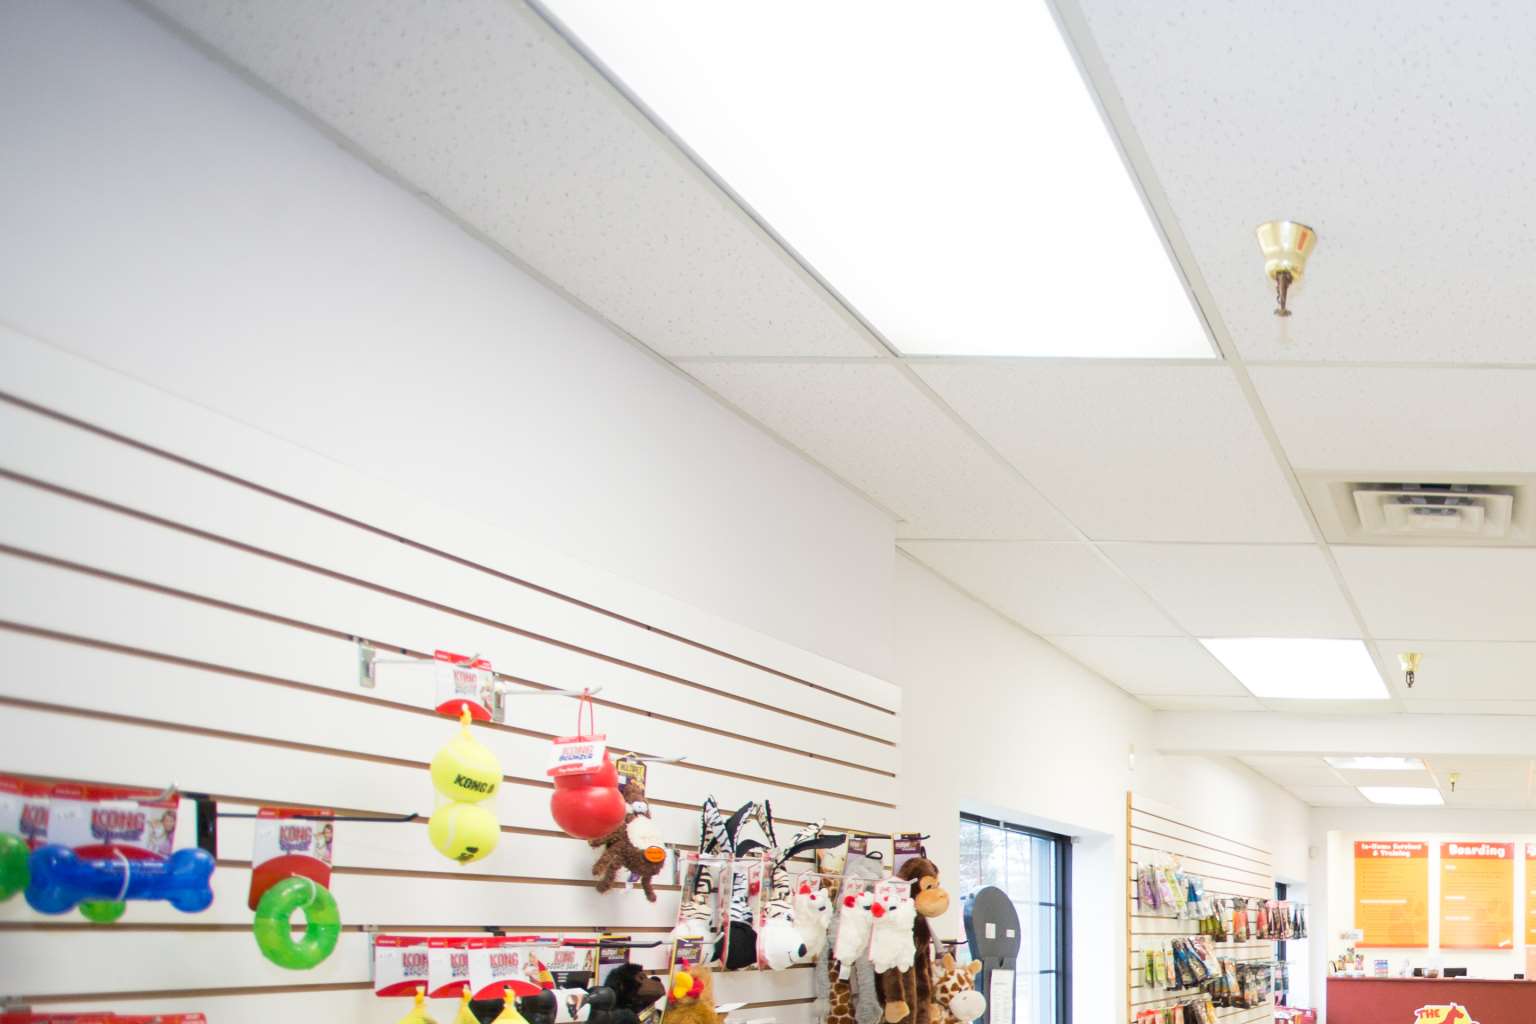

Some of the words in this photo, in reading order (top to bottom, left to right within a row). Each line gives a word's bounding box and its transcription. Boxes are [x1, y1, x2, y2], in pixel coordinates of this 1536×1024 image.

[454, 773, 488, 793] KONG
[91, 808, 145, 831] KONG
[279, 825, 313, 842] KONG
[1449, 844, 1505, 857] Boarding
[489, 953, 519, 968] KONG
[1417, 1009, 1440, 1019] THE
